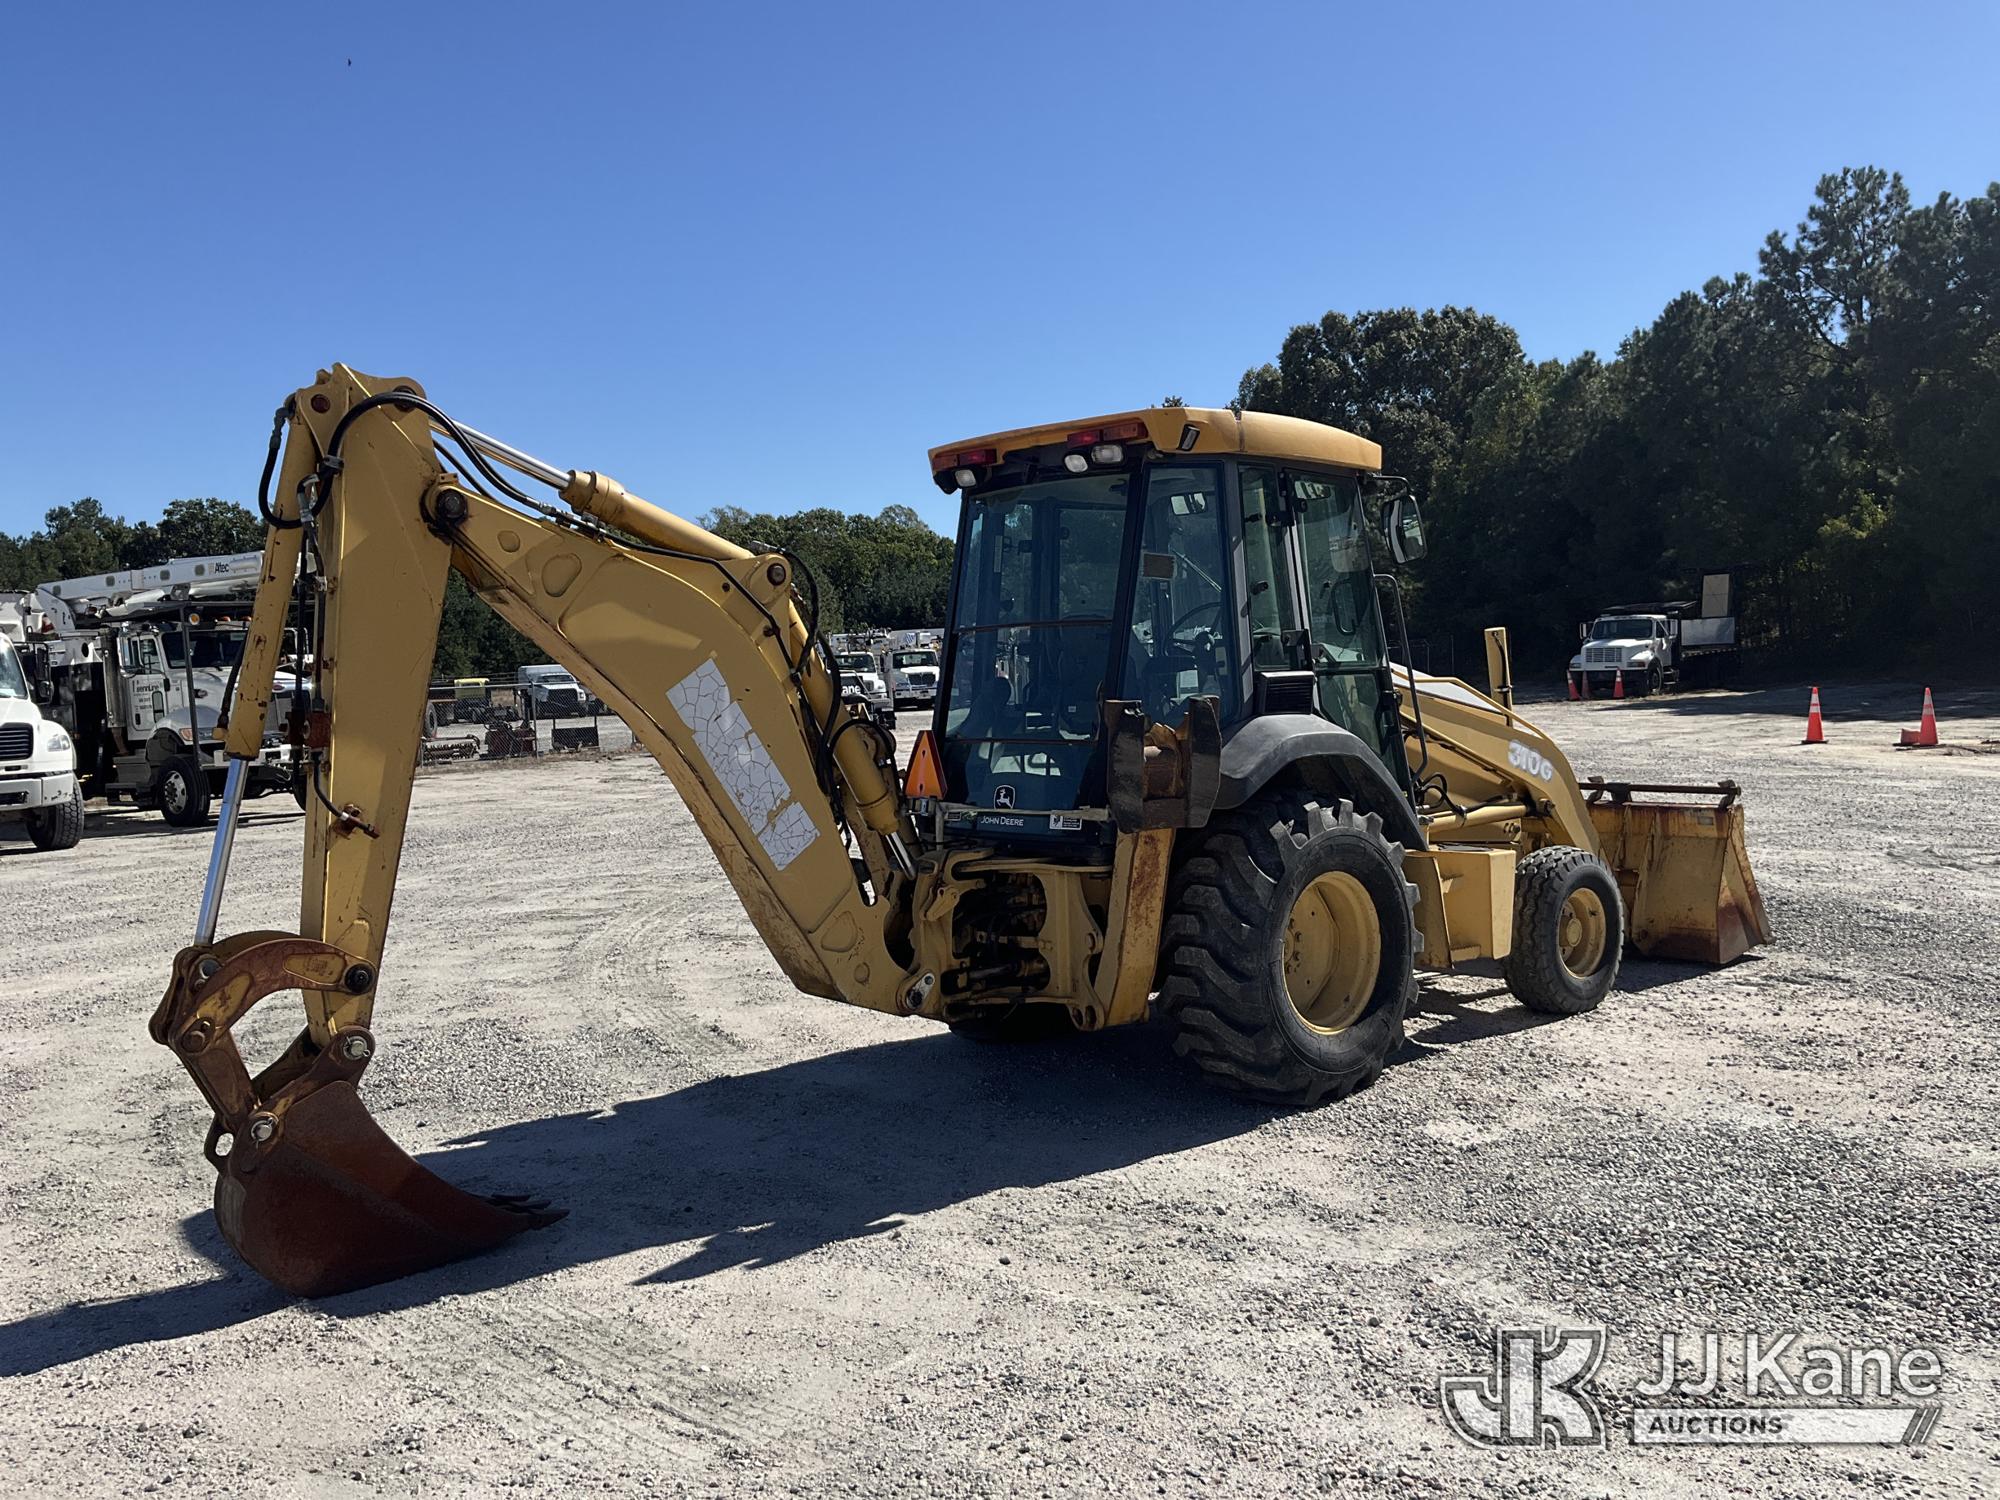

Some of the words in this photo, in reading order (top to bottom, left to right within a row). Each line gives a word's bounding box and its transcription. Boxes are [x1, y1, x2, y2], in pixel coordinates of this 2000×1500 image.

[841, 685, 861, 695] ane
[1508, 741, 1553, 781] 310G
[980, 816, 999, 825] JOHN
[1000, 817, 1024, 826] DEERE
